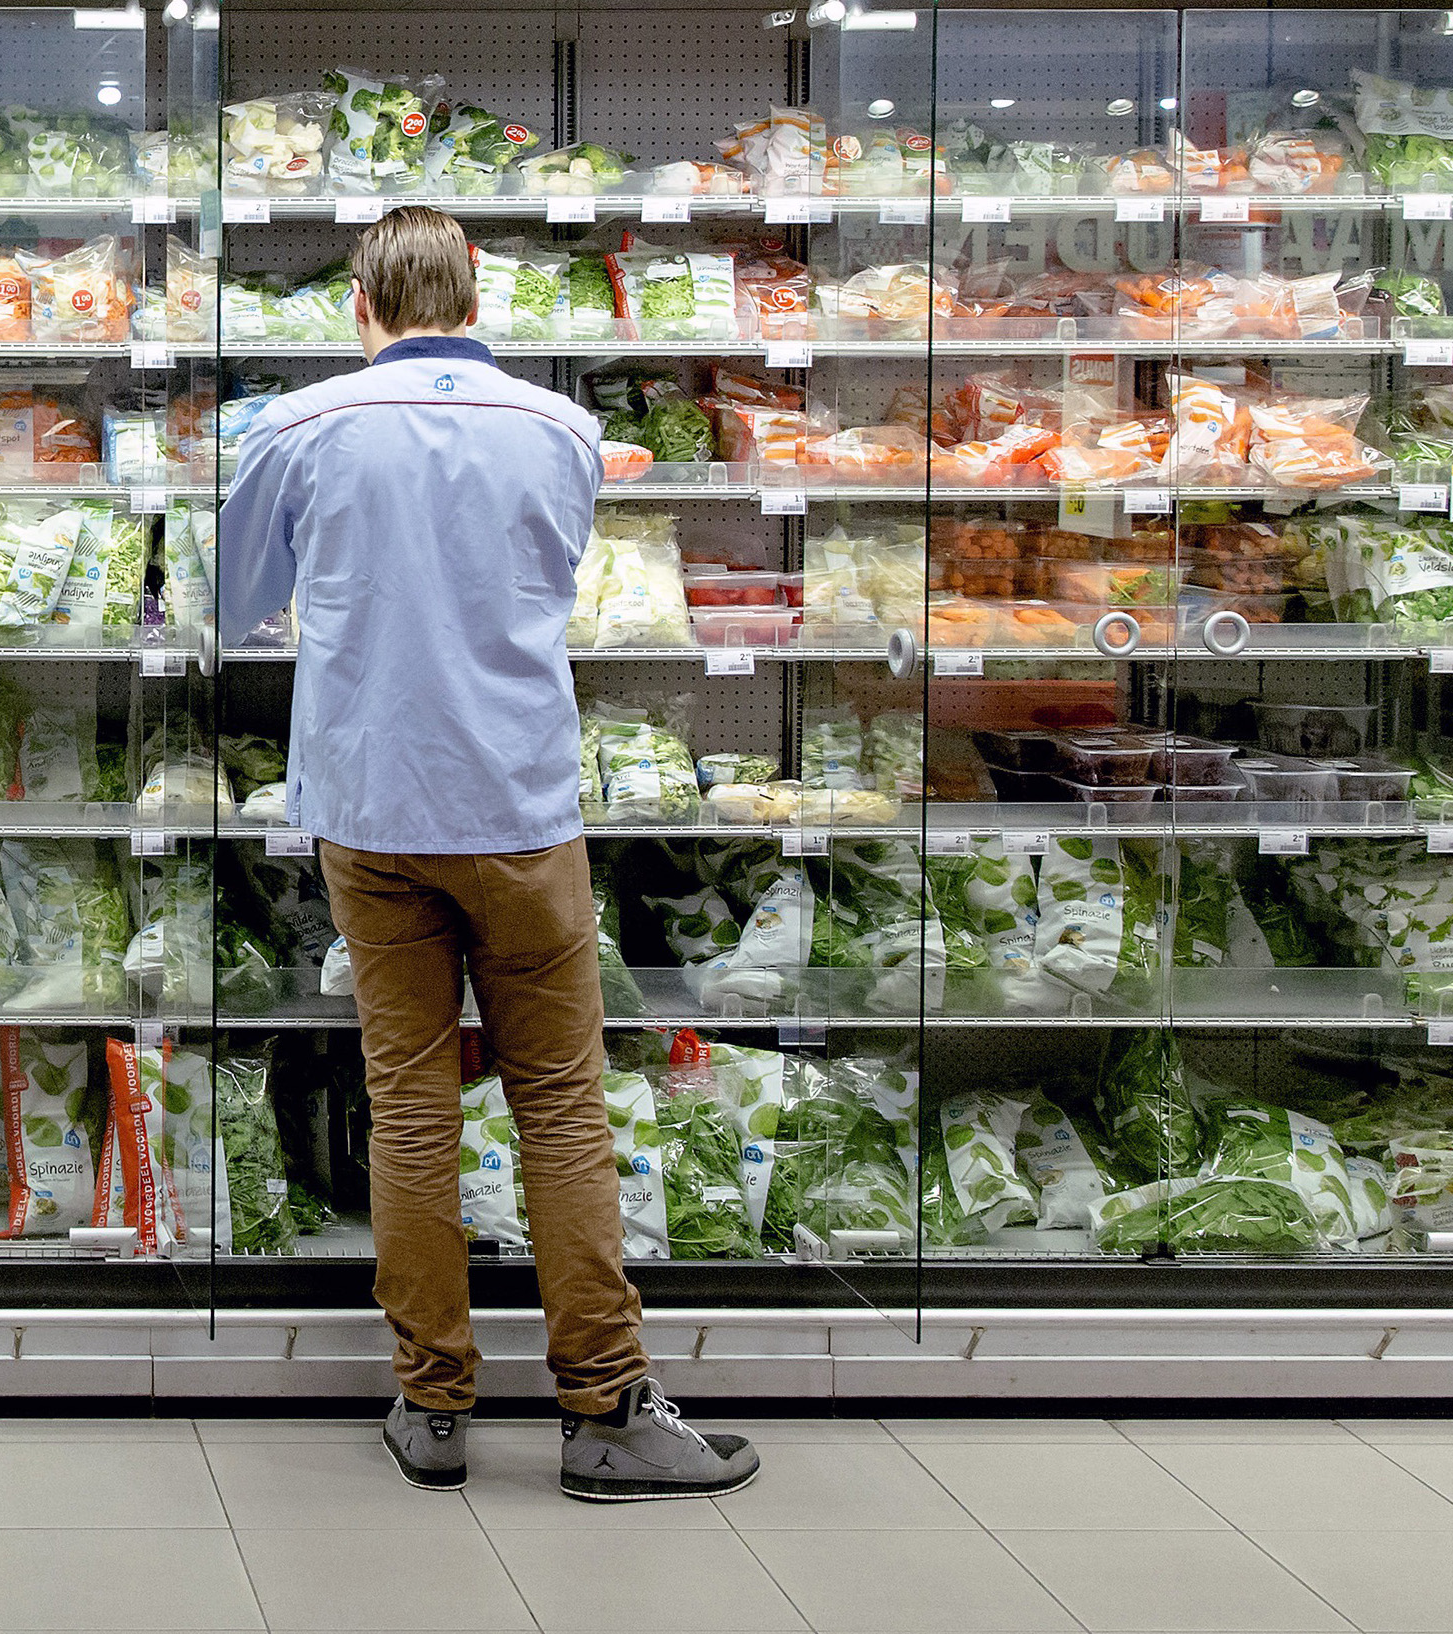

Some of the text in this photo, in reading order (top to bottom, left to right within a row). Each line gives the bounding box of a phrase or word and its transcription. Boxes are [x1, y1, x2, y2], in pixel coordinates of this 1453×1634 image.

[404, 118, 423, 131] 2.00
[507, 127, 528, 140] 2.00
[74, 294, 90, 306] 1.00
[438, 379, 453, 390] ah
[1063, 904, 1111, 922] Spinazie
[1000, 932, 1037, 947] Spinaz
[8, 1034, 17, 1073] VOORD
[470, 1030, 482, 1071] VOORD
[10, 1092, 19, 1137] VOORD
[133, 1113, 147, 1160] VOORD
[1027, 1143, 1073, 1161] Spinazie
[29, 1160, 84, 1177] Spinazie
[101, 1138, 112, 1196] VOORDEEL
[139, 1162, 154, 1224] VOORDEEL
[619, 1187, 653, 1203] inazie
